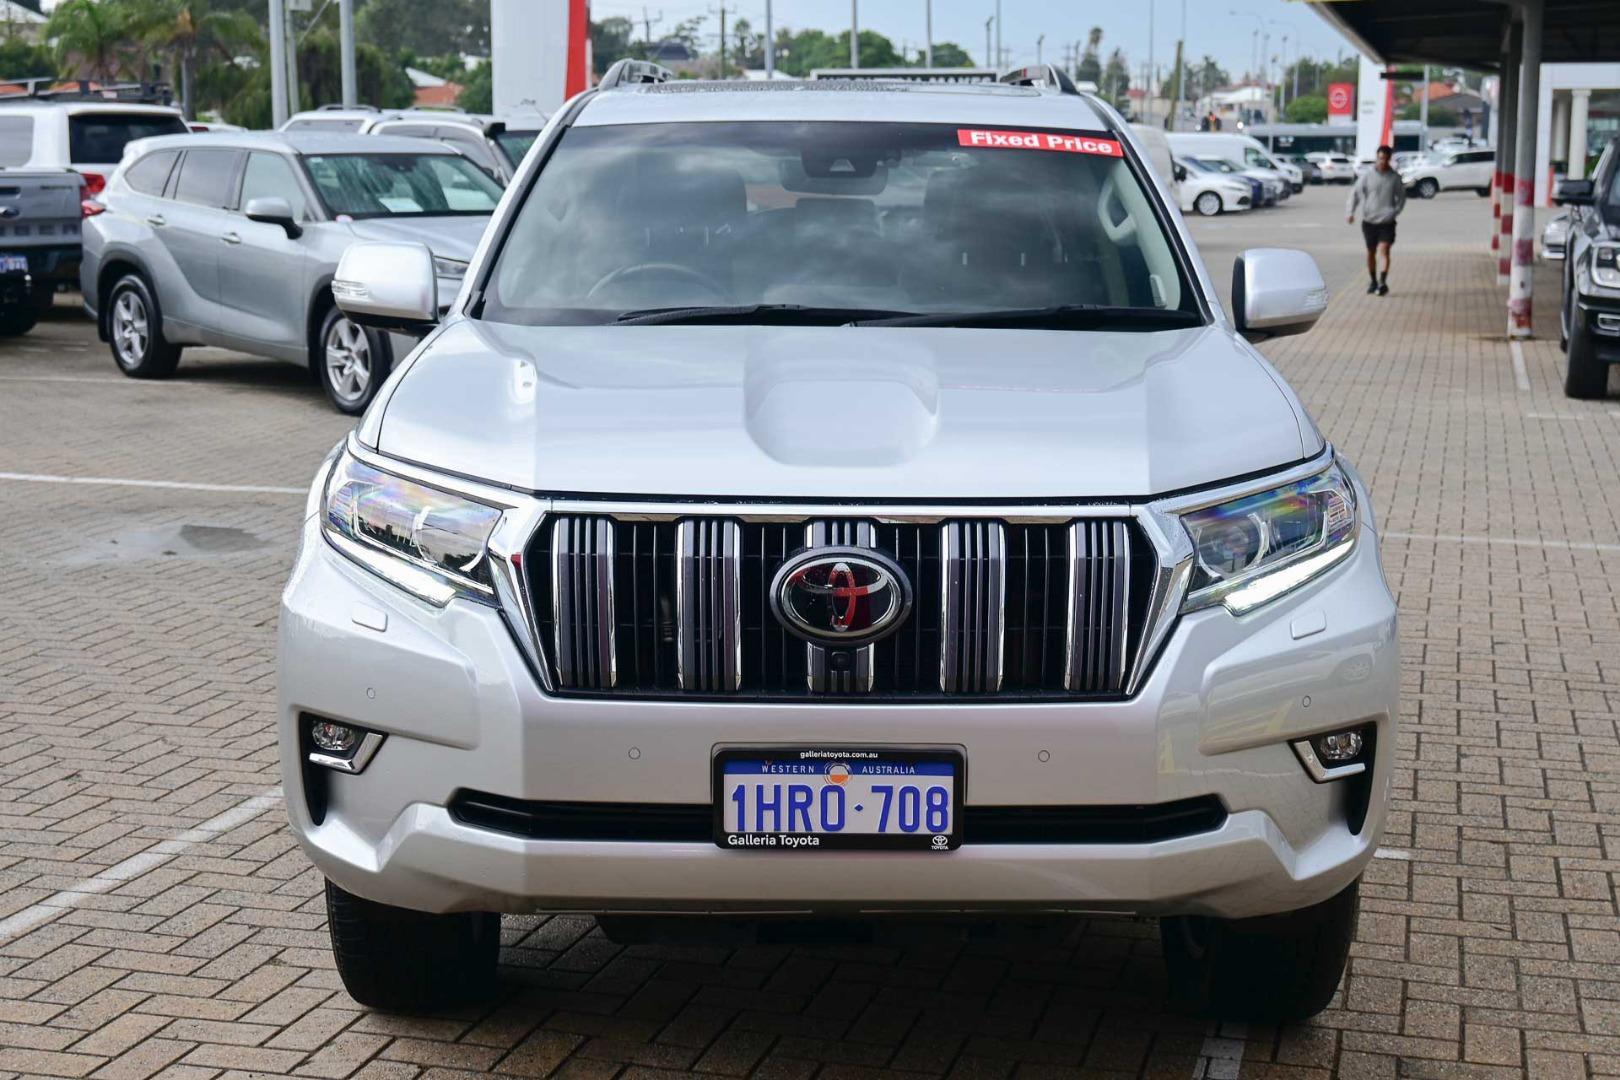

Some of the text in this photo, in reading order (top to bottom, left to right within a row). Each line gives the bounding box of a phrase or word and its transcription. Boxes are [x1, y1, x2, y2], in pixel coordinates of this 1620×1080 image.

[970, 131, 1111, 153] Fixed Price
[800, 750, 879, 760] galleriatoyota.com.au
[762, 765, 914, 774] WESTERN AUSTRALIA
[728, 836, 820, 847] Galleria Toyota
